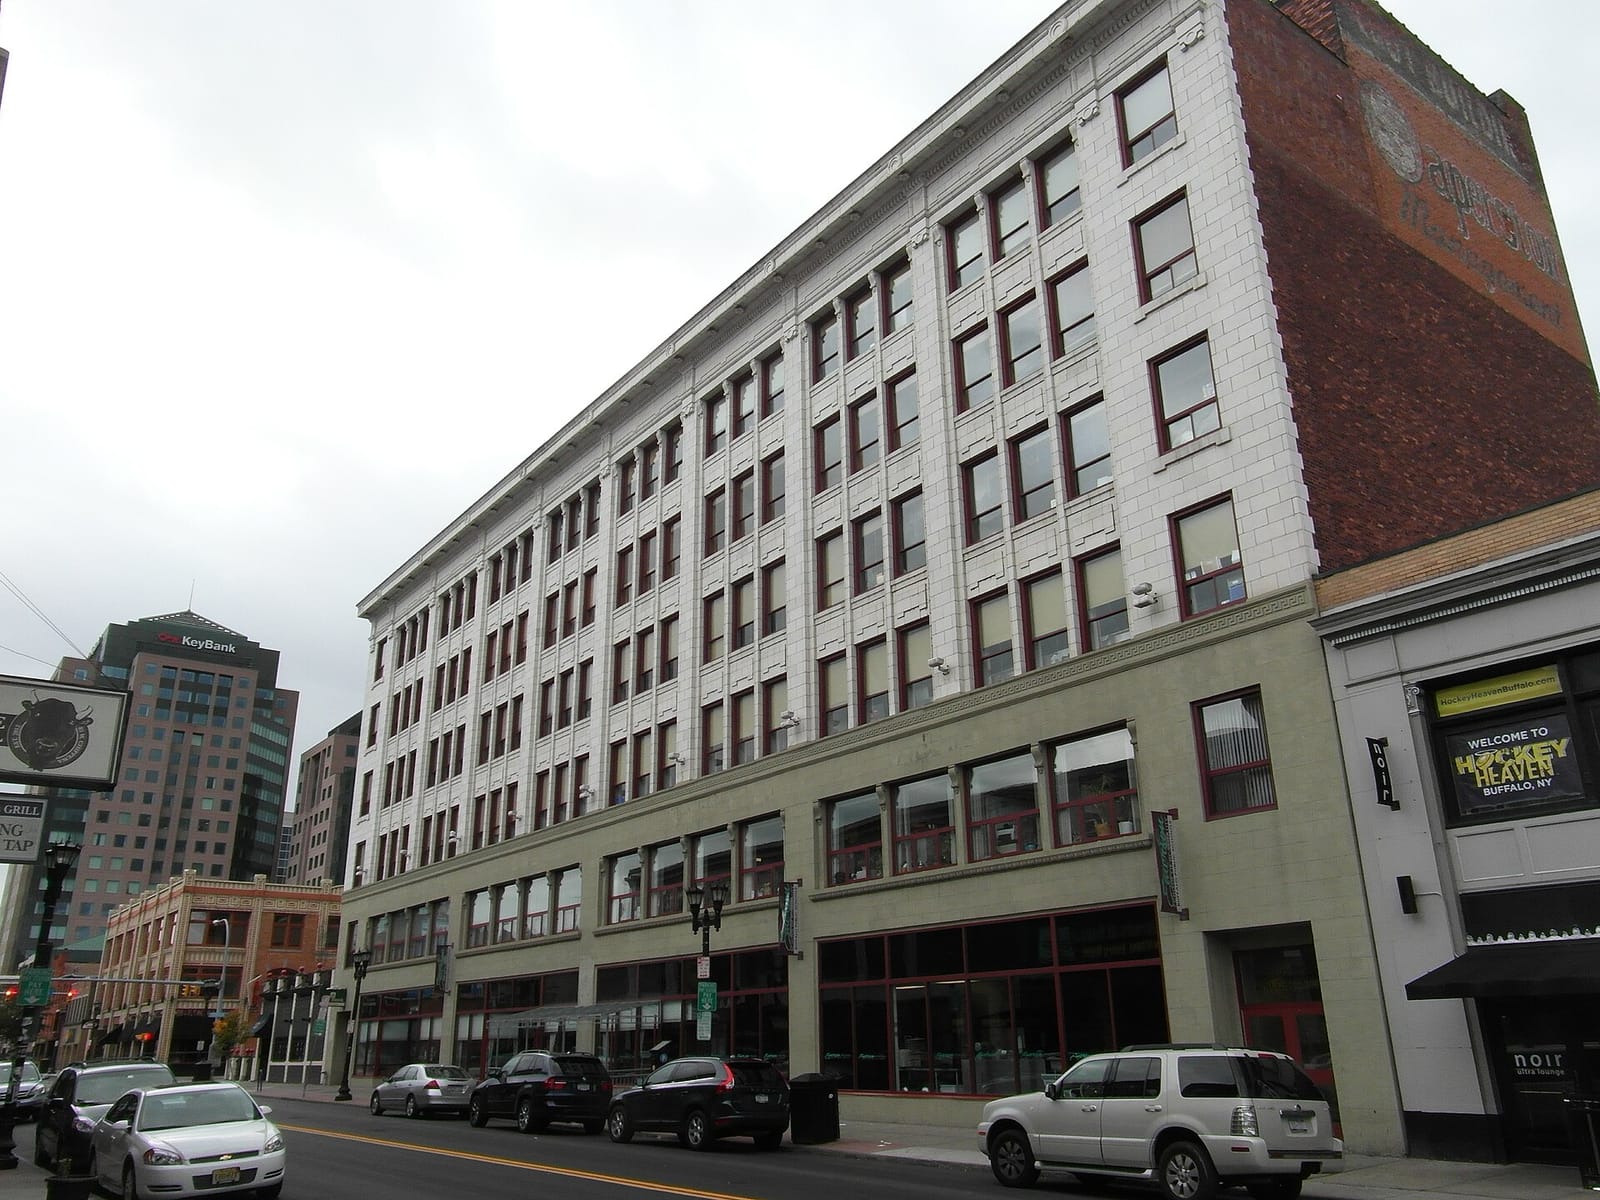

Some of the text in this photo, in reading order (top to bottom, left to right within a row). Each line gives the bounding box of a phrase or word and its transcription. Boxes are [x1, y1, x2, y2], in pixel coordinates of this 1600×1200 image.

[182, 635, 236, 653] KeyBank
[1440, 675, 1556, 706] HockeyHeavenBuffalo.com
[1468, 727, 1548, 749] WELCOME TO
[1373, 743, 1390, 801] noir
[1475, 757, 1555, 788] HEAVEN
[1483, 778, 1552, 797] BUFFALO, NY
[3, 804, 40, 816] GRILL
[3, 838, 34, 852] TAP
[1513, 1054, 1563, 1068] noir
[1517, 1068, 1565, 1078] ultra lounge
